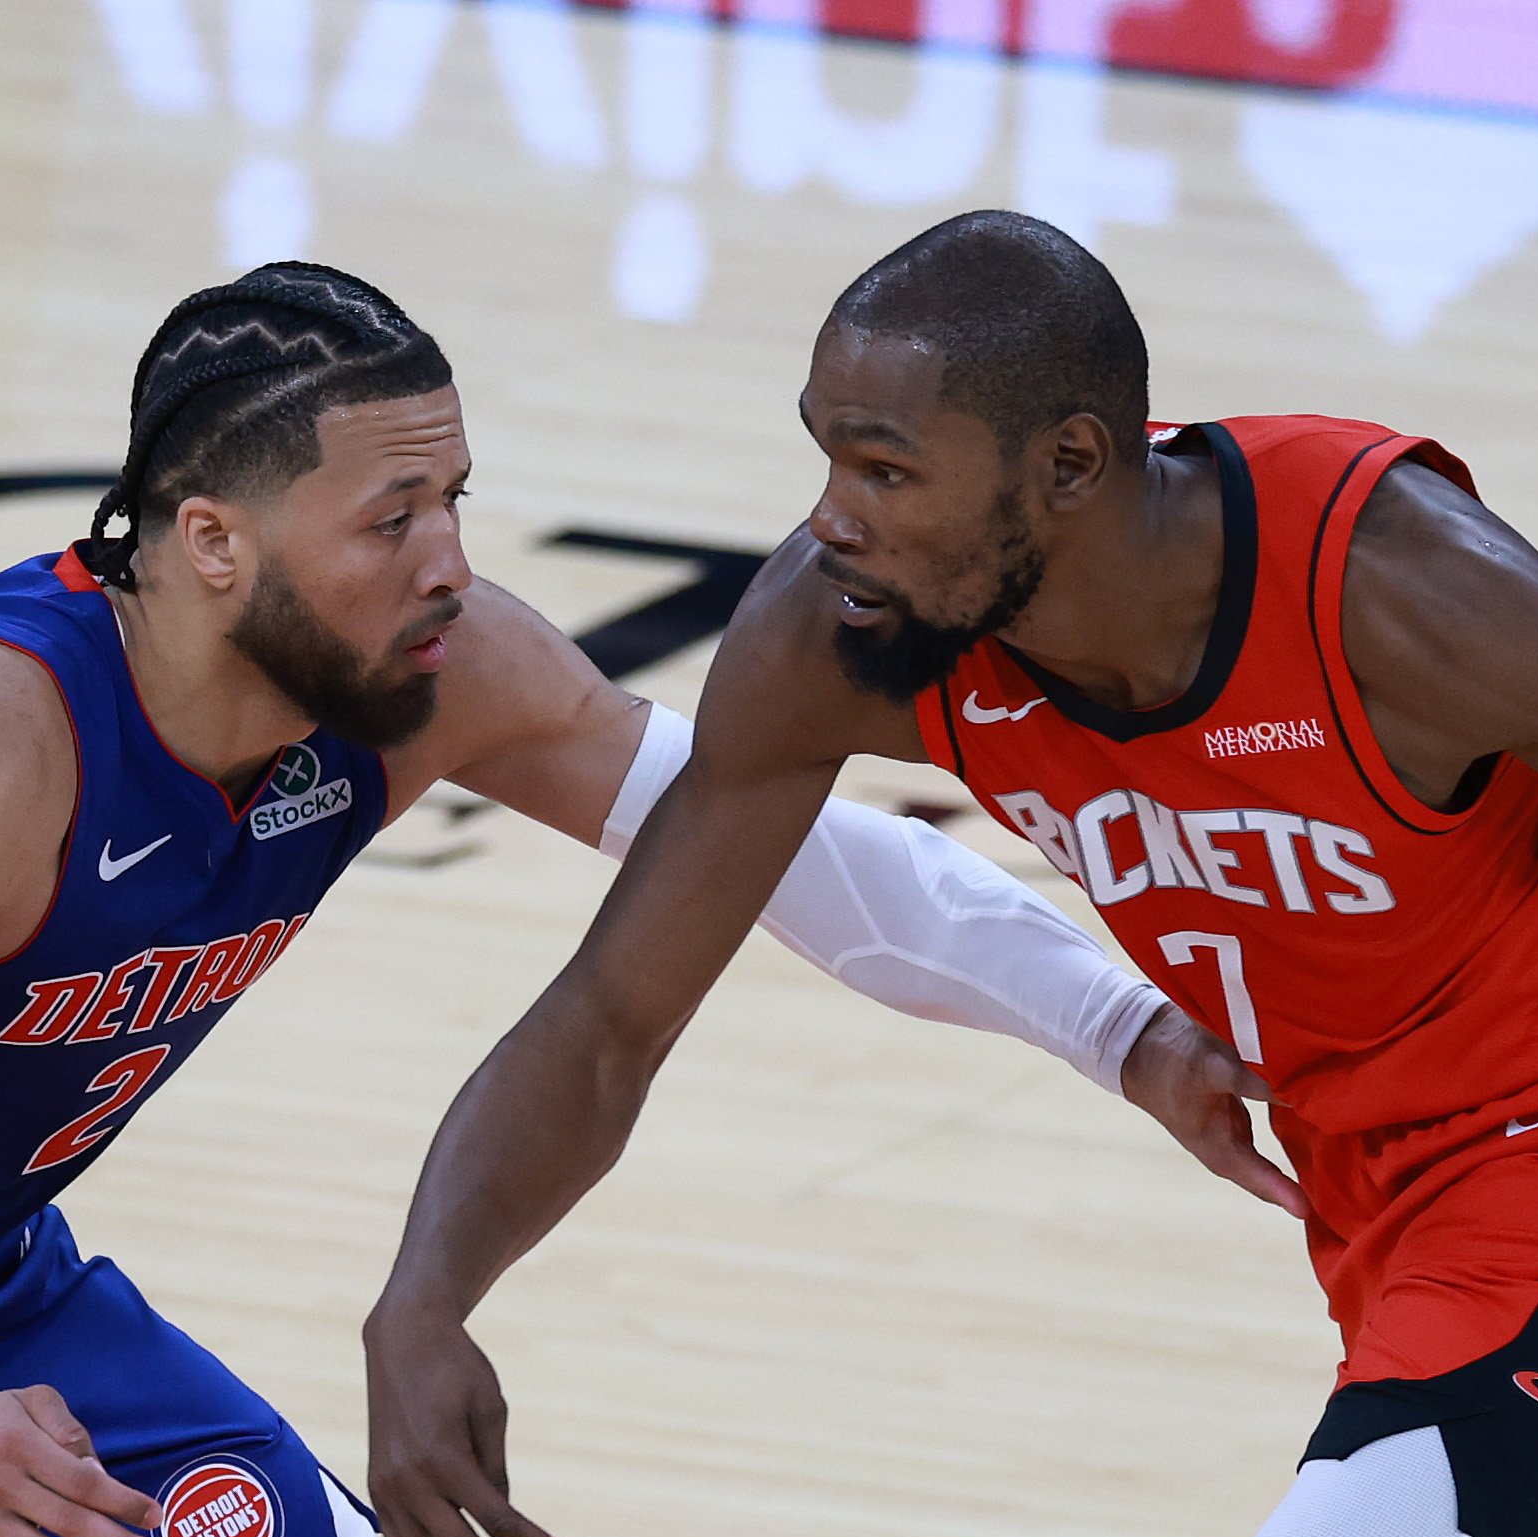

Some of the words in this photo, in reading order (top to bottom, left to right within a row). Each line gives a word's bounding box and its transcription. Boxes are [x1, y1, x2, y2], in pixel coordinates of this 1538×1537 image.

[1204, 718, 1324, 748] MEMORIAL
[1206, 731, 1326, 758] HERMANN
[253, 780, 349, 835] StockX
[1156, 930, 1264, 1065] 7
[21, 1043, 172, 1176] 2
